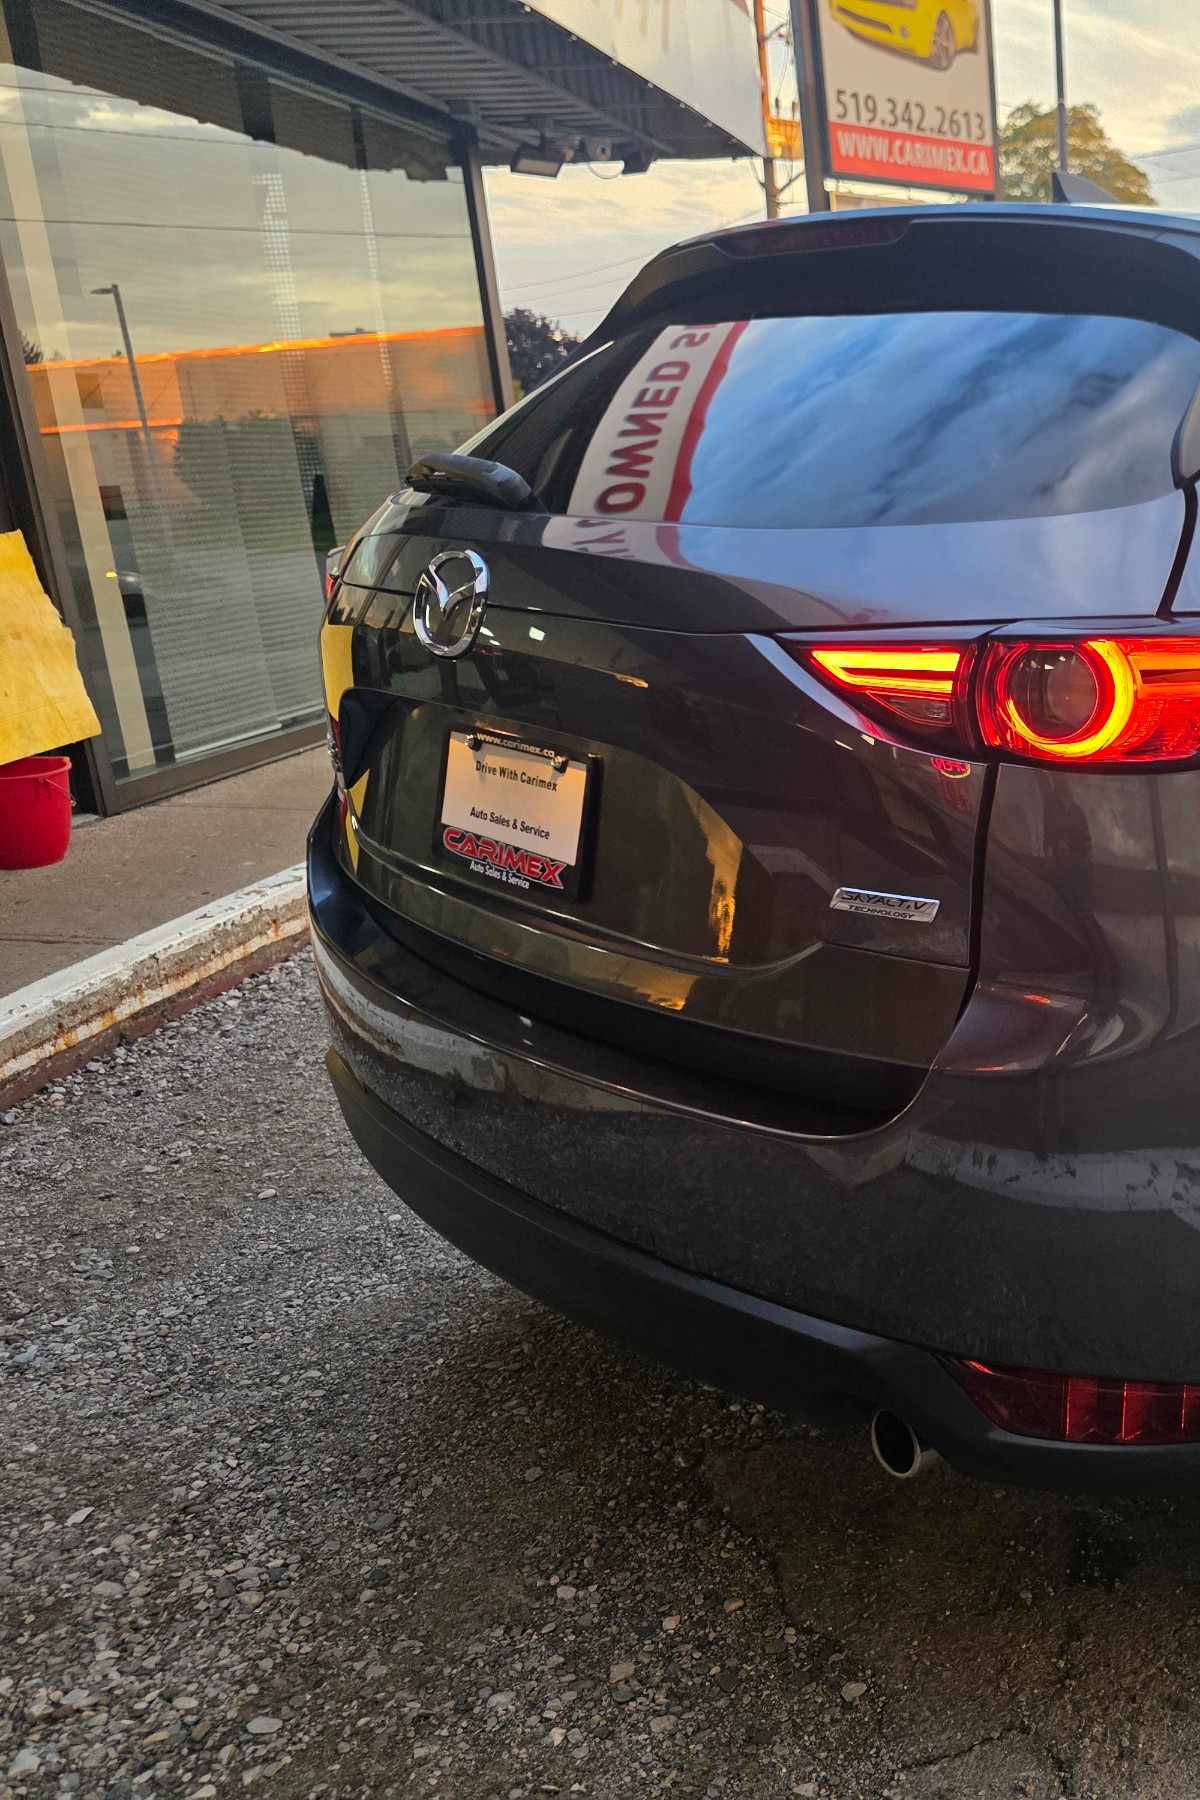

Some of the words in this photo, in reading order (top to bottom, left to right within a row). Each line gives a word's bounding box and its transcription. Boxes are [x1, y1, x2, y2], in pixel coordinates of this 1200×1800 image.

[836, 89, 985, 141] 519.342.2613
[838, 130, 989, 176] WWW.CARIMEX.CA
[476, 732, 555, 758] www.carimex.ca
[476, 760, 497, 776] Drive
[499, 766, 519, 782] With
[520, 772, 557, 792] Carimex
[470, 806, 488, 821] Auto
[489, 811, 510, 828] Sales
[512, 819, 518, 829] &
[520, 821, 550, 840] Service
[443, 827, 566, 888] CARIMEX
[470, 861, 484, 874] Auto
[485, 865, 501, 880] Sales
[501, 871, 507, 881] &
[507, 873, 530, 889] Service
[848, 904, 915, 919] TECHNOLOGY
